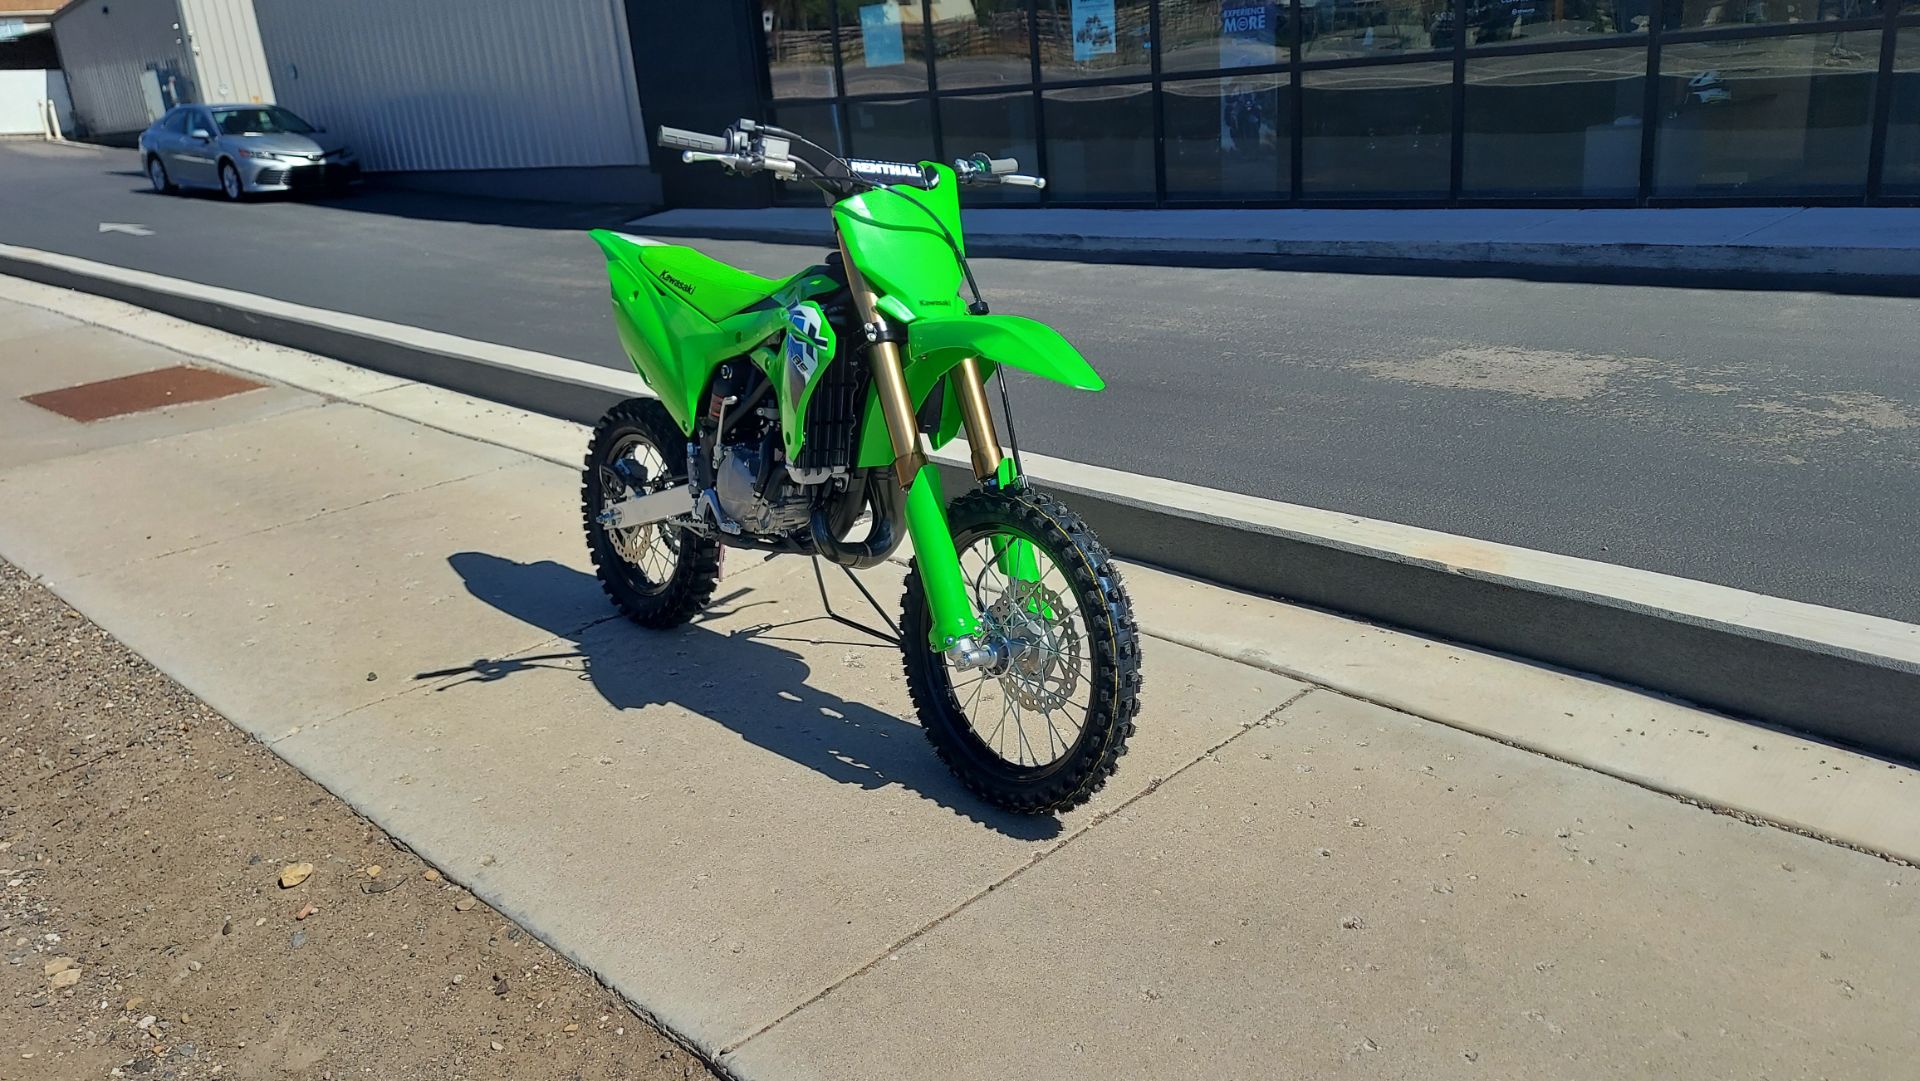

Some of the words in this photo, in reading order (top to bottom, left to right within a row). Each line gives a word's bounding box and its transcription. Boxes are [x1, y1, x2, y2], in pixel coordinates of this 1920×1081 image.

[1224, 15, 1266, 33] MORE
[851, 161, 922, 177] RENTHAL
[658, 269, 697, 295] Kawasaki
